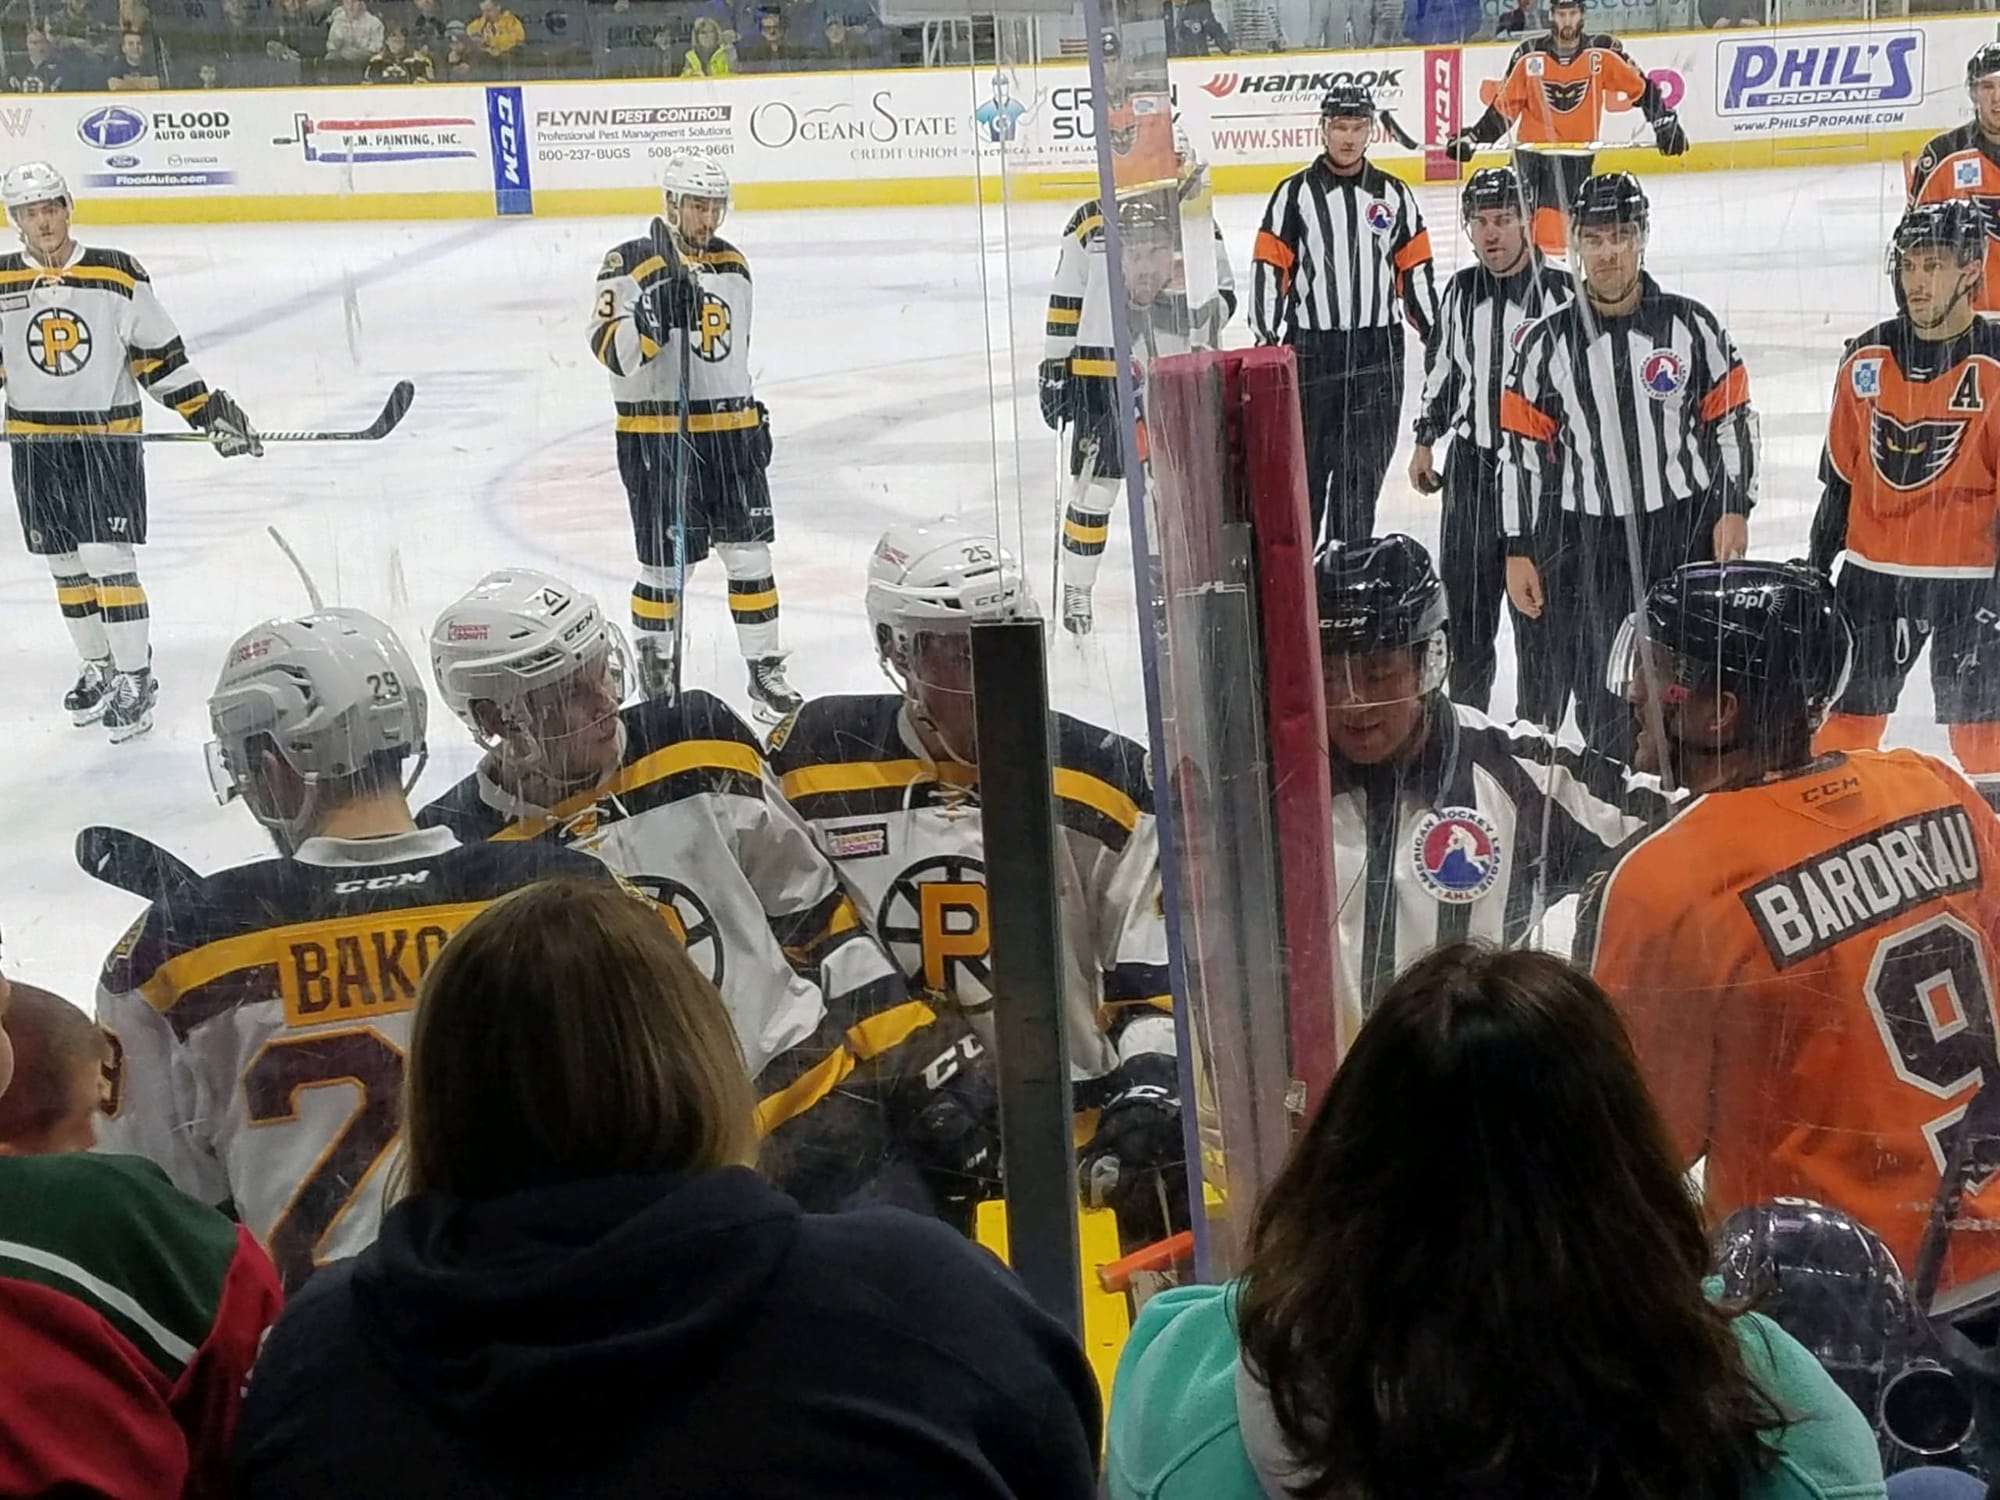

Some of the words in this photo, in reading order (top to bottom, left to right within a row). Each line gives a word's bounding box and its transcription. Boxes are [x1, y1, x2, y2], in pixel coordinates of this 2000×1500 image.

[1724, 36, 1917, 109] PHIL'S
[1765, 87, 1882, 105] PROPANE
[152, 111, 230, 129] FLOOD
[536, 109, 609, 127] FLYNN
[614, 109, 652, 124] PEST
[656, 107, 728, 122] CONTROL
[154, 130, 186, 141] AUTO
[189, 129, 231, 140] GROUP
[375, 134, 435, 147] PAINTING,
[437, 133, 462, 145] INC.
[497, 94, 520, 186] CCM
[537, 129, 597, 142] Professional
[599, 129, 620, 140] Pest
[621, 128, 686, 142] Management
[688, 126, 732, 138] Solutions
[538, 148, 631, 161] 800-237-BUGS
[850, 147, 904, 160] CREDIT
[907, 146, 959, 159] UNION
[115, 174, 208, 186] FloodAuto.com
[598, 289, 615, 318] 3
[1948, 361, 1985, 412] A
[961, 544, 993, 564] 25
[1733, 591, 1766, 609] ppl
[563, 610, 594, 642] CCM
[1318, 616, 1368, 628] CCM
[366, 671, 401, 701] 29
[1801, 777, 1860, 803] CCM
[334, 870, 431, 894] CCM
[1754, 812, 1979, 957] BARDREAU
[243, 1024, 407, 1290] 2
